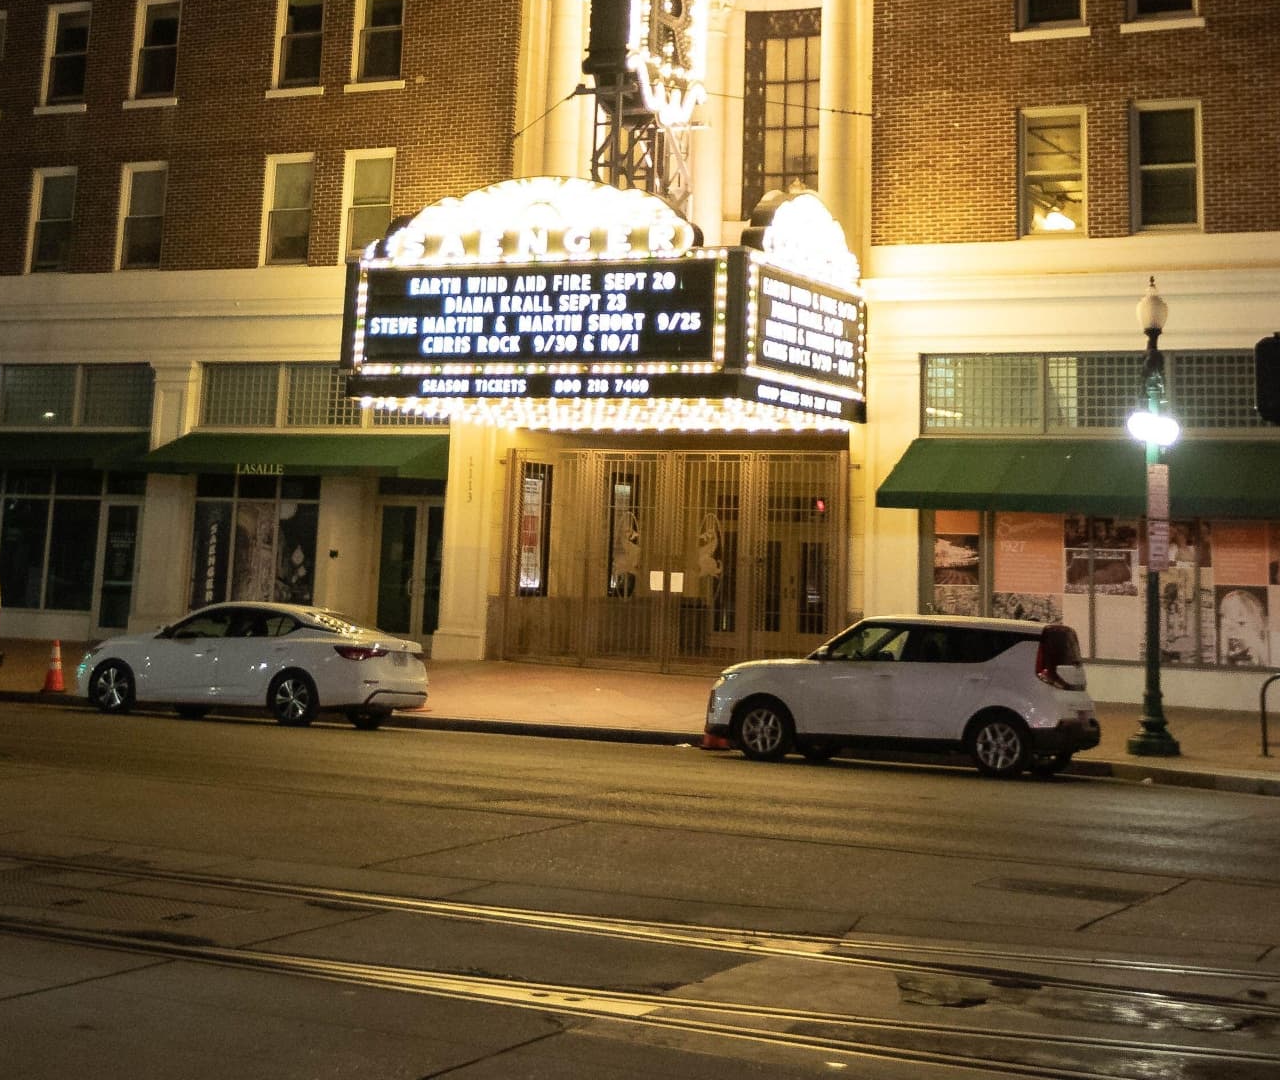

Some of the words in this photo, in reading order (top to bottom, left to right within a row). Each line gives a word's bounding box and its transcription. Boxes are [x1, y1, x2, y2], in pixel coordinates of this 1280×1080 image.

[400, 224, 676, 257] SAENGER
[411, 278, 461, 295] EARTH
[468, 277, 508, 293] WIND
[515, 276, 546, 292] AND
[553, 274, 591, 291] FIRE
[605, 273, 647, 290] SEPT
[653, 272, 676, 290] 20
[445, 296, 494, 313] DIANA
[501, 295, 552, 313] KRALL
[559, 294, 601, 311] SEPT
[607, 293, 627, 310] 23
[371, 317, 417, 334] STEVE
[423, 316, 483, 333] MARTIN
[495, 315, 506, 332] &
[519, 314, 582, 331] MARTIN
[588, 313, 645, 331] SHORT
[657, 313, 701, 331] 9/25
[423, 336, 470, 353] CHRIS
[477, 335, 520, 353] ROCK
[534, 335, 577, 352] 9/30
[583, 334, 593, 351] &
[601, 334, 639, 351] 10/1
[423, 380, 469, 392] SEASON
[475, 380, 526, 392] TICKETS
[236, 462, 284, 475] LASALLE
